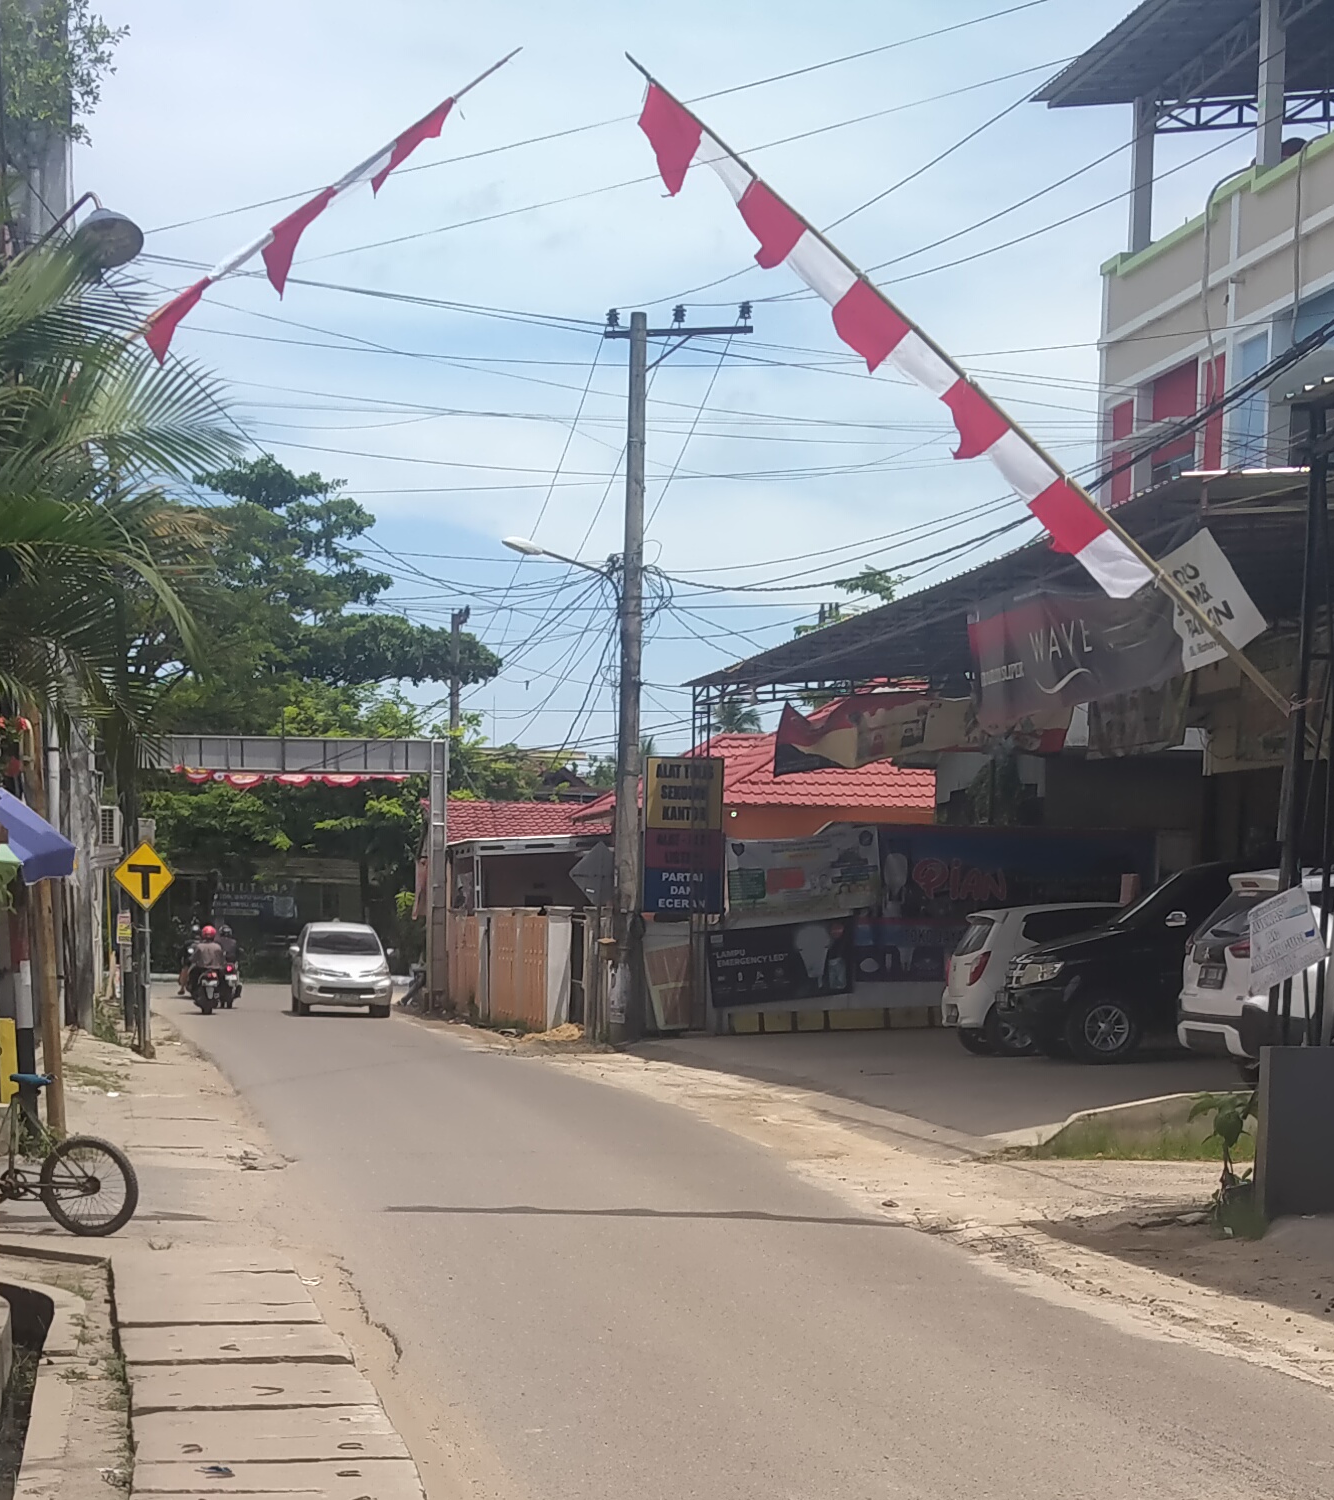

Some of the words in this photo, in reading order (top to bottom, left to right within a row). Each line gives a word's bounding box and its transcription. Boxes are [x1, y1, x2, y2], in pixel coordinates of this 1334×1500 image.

[1029, 618, 1093, 664] WAVE
[661, 872, 704, 882] PARTAI
[717, 955, 767, 967] EMERGENCY
